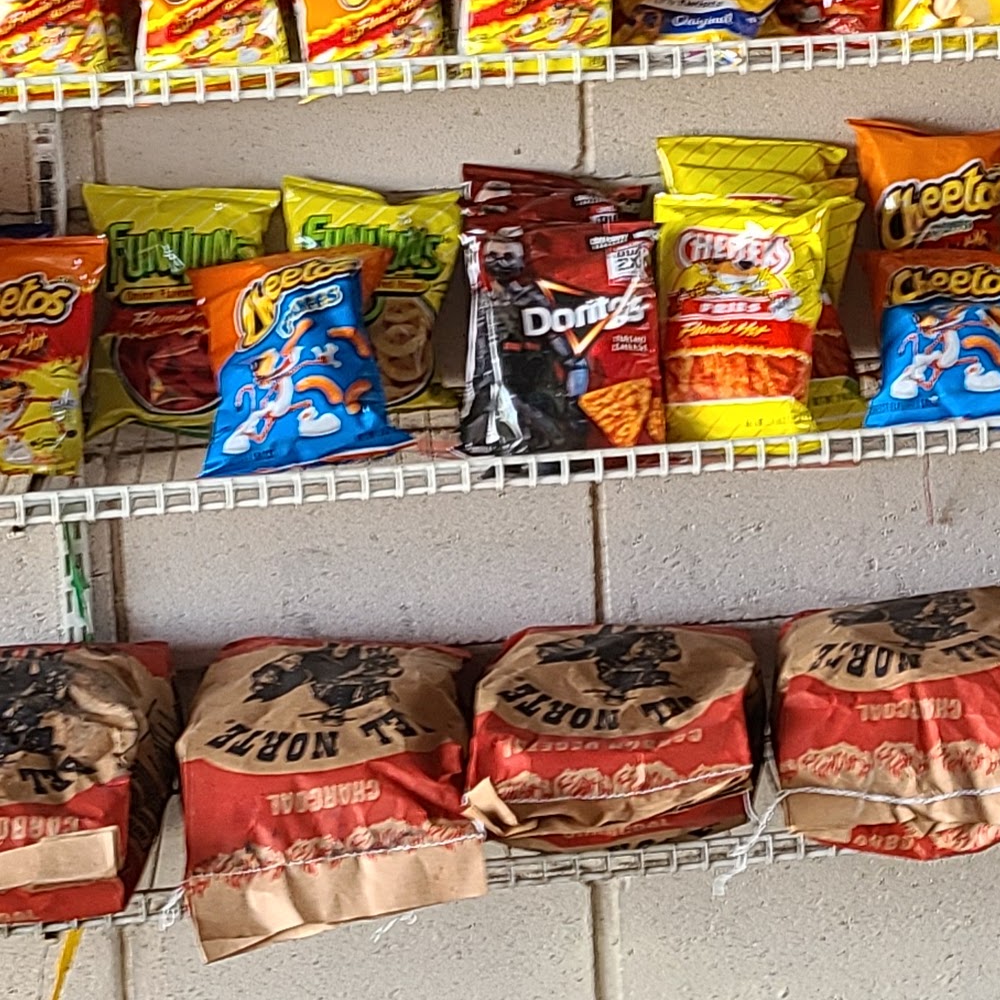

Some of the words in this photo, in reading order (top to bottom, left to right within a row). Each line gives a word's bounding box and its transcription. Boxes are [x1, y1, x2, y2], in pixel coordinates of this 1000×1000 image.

[521, 294, 647, 337] Doritos
[497, 683, 620, 731] NORTE
[205, 722, 340, 762] NORTE
[267, 779, 381, 816] CHARCOAL
